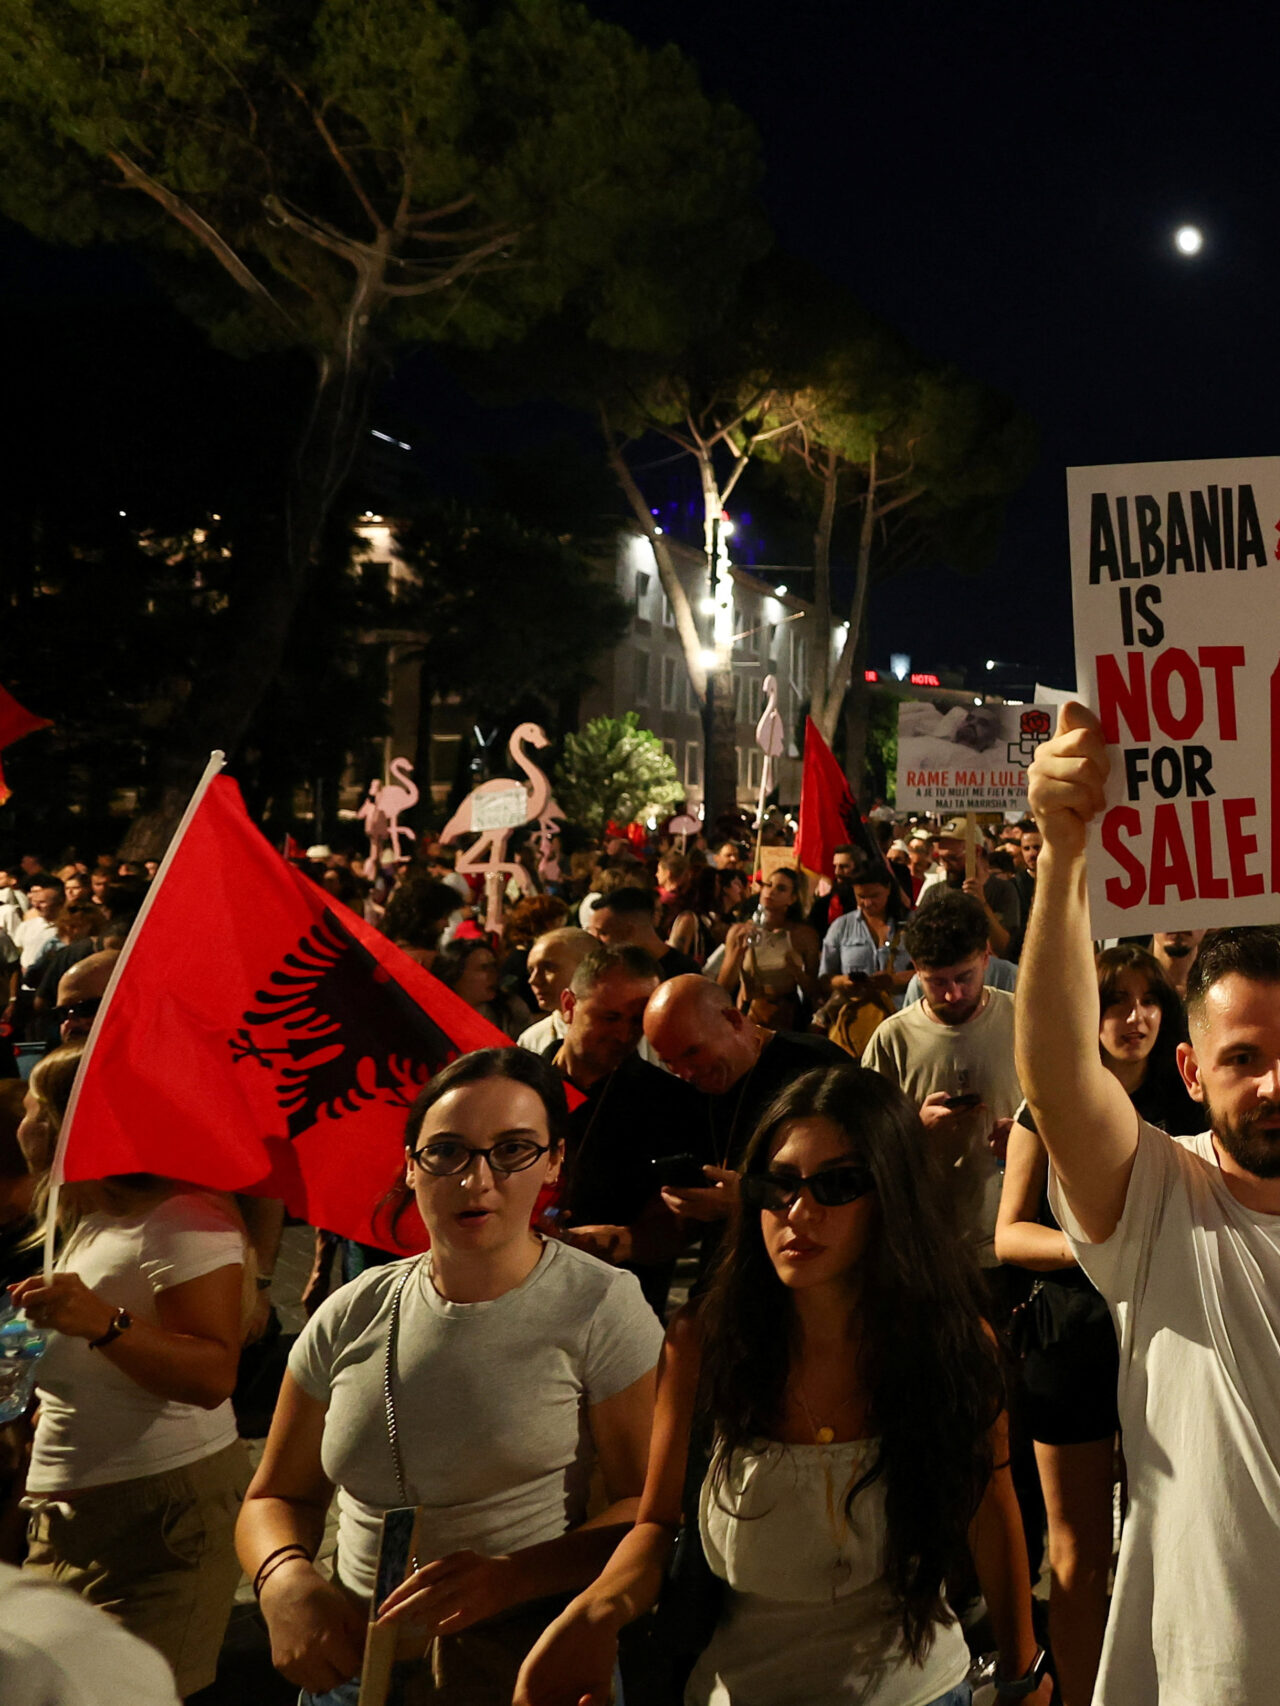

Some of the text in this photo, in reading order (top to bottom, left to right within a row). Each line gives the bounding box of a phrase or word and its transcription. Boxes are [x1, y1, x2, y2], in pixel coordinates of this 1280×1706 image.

[1089, 484, 1268, 585] ALBANIA
[1119, 583, 1165, 648] IS
[911, 673, 940, 687] HOTEL
[1096, 646, 1246, 745] NOT
[907, 770, 1026, 787] RAME MAJ LULE
[916, 788, 921, 797] A
[1124, 745, 1217, 801] FOR
[1100, 797, 1265, 910] SALE
